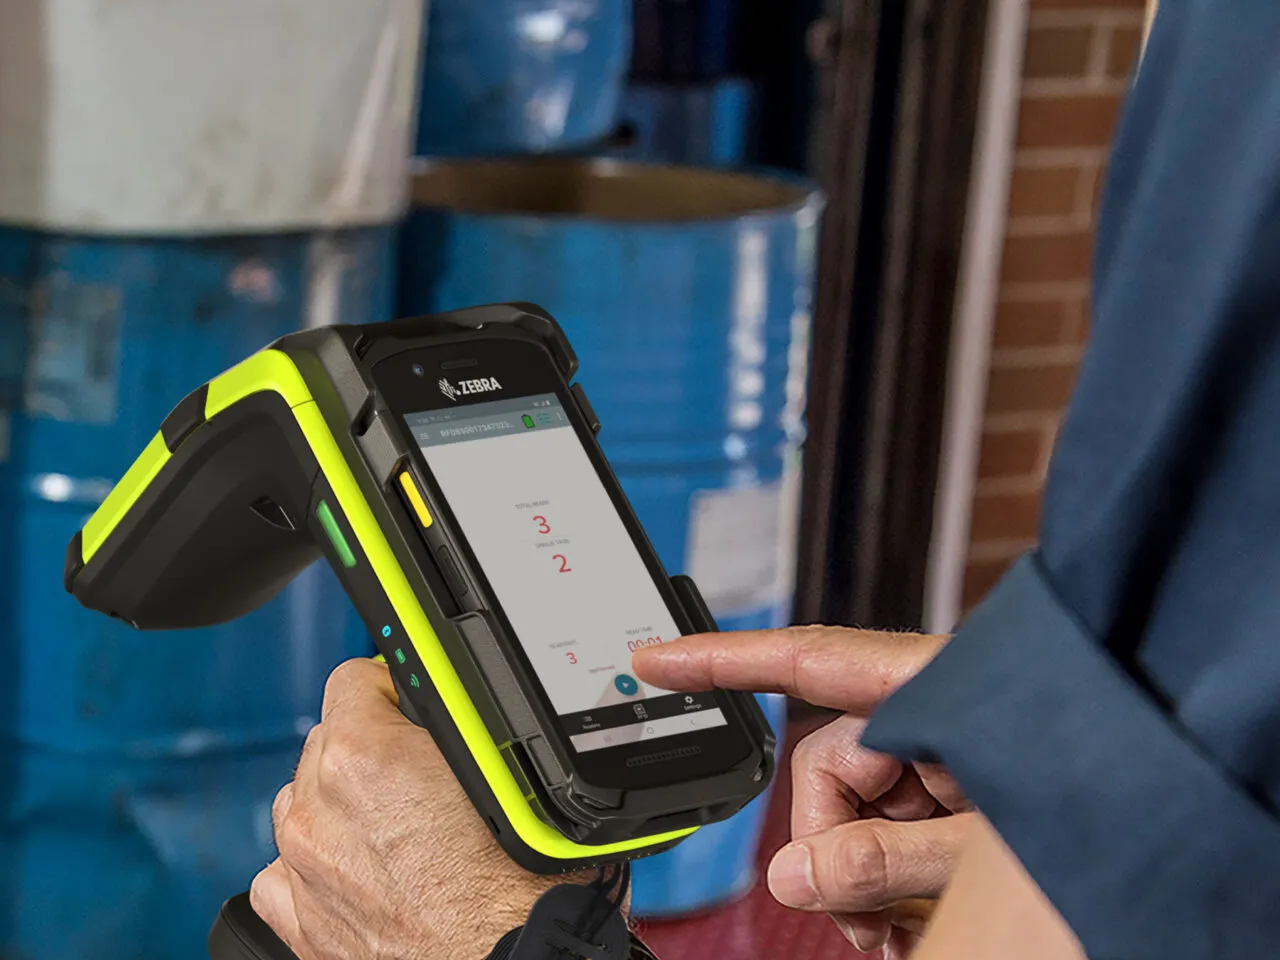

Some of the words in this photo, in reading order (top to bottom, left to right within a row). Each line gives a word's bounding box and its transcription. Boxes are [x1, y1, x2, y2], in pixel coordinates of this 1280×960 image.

[458, 377, 502, 394] ZEBRA
[533, 515, 551, 534] 3
[552, 554, 572, 573] 2
[565, 651, 578, 665] 3
